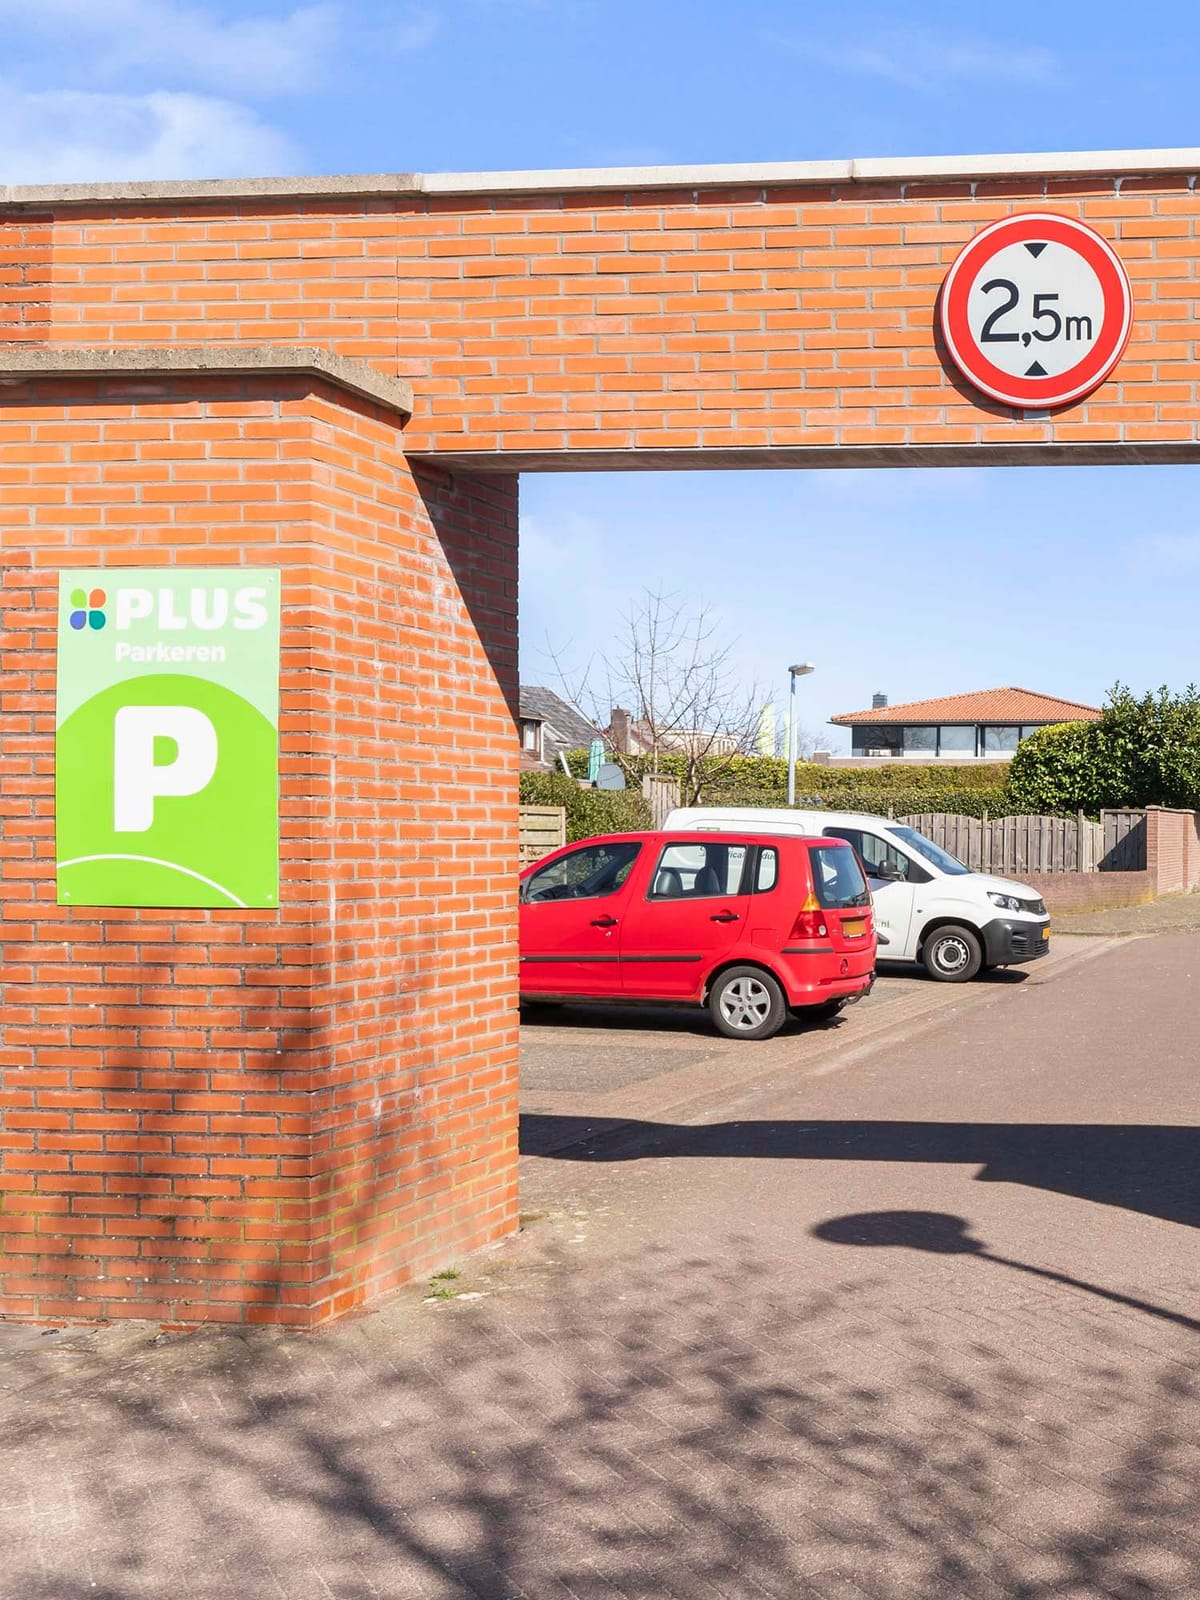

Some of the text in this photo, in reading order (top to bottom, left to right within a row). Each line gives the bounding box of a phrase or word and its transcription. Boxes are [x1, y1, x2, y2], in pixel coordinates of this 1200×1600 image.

[115, 587, 268, 631] PLUS
[115, 642, 226, 663] Parkeren
[114, 705, 218, 832] P
